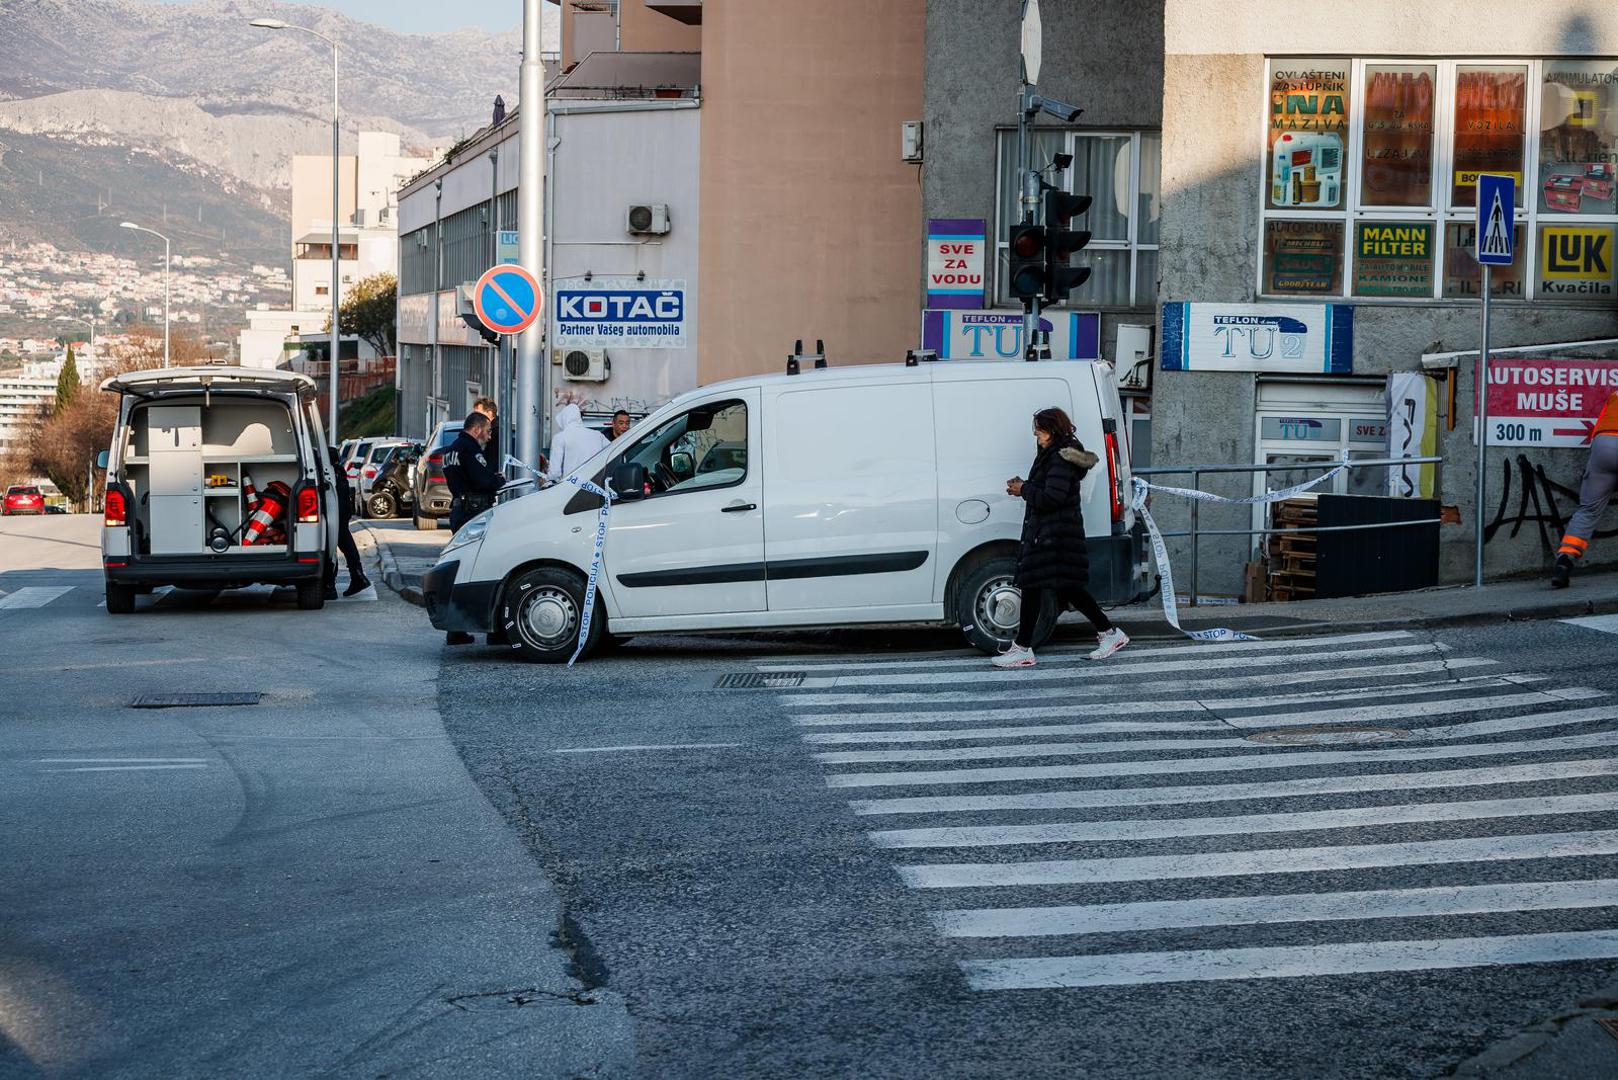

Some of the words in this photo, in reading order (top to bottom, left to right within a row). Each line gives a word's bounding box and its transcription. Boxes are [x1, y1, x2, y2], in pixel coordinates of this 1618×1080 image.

[1275, 68, 1346, 81] OVLAŠTENI
[1273, 81, 1345, 92] ZASTUPNIK
[1273, 119, 1345, 130] MAZIVA
[1363, 227, 1426, 241] MANN
[939, 244, 974, 255] SVE
[1286, 239, 1330, 248] MICHELI
[1363, 242, 1425, 255] FILTER
[944, 259, 968, 269] ZA
[932, 274, 981, 285] VODU
[1358, 274, 1429, 283] KAMIONE
[1448, 279, 1522, 295] ILRI
[1542, 281, 1611, 294] Kvačila
[560, 291, 680, 319] KOTAČ
[964, 315, 1006, 323] TEFLON
[1215, 316, 1259, 325] TEFLON
[560, 323, 595, 335] Partner
[597, 323, 624, 336] Vašeg
[626, 323, 680, 336] automobila
[1517, 388, 1584, 411] MUŠE
[1356, 425, 1376, 437] SVE
[1377, 425, 1386, 437] Z
[1496, 423, 1525, 441] 300
[1529, 427, 1542, 441] m
[595, 521, 606, 548] STOP
[580, 611, 590, 638] STOP
[586, 560, 600, 606] POLICIJA
[1203, 629, 1227, 640] STOP
